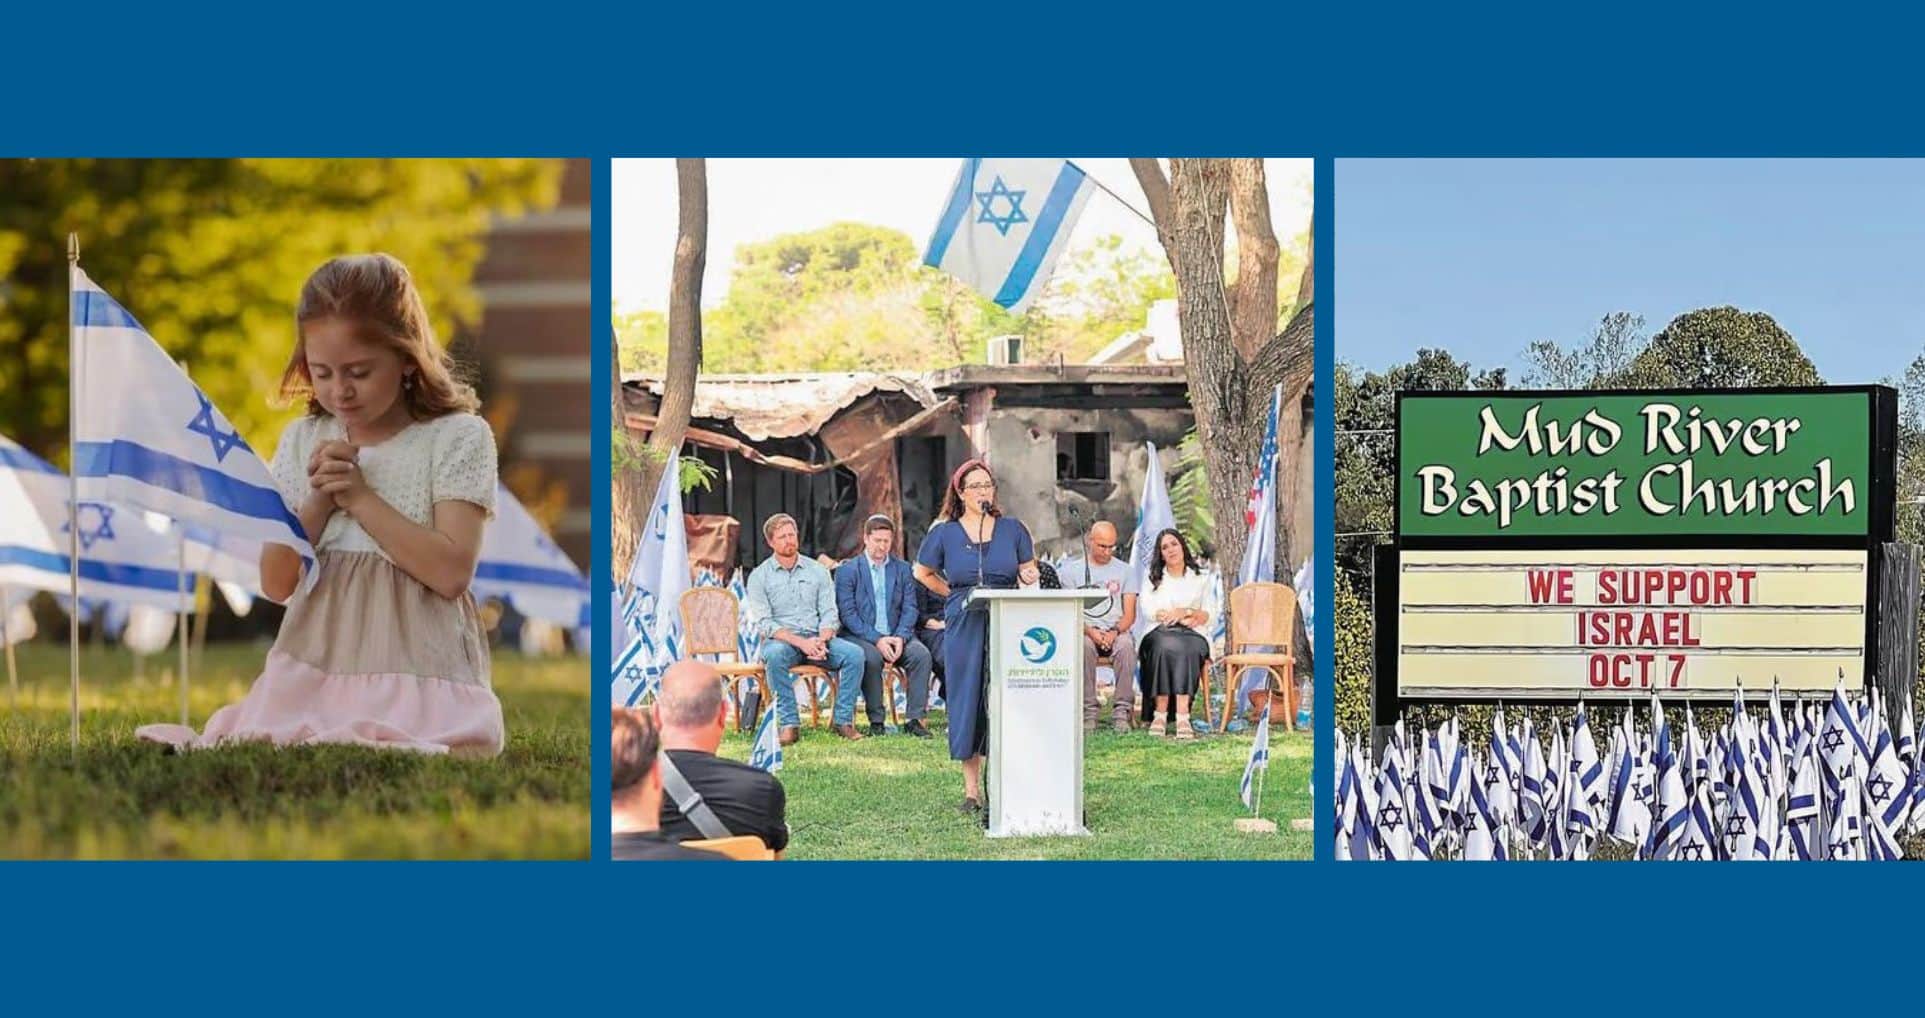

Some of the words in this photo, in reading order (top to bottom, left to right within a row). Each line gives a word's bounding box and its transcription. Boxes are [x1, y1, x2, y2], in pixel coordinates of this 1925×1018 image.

[1478, 402, 1623, 457] Mud
[1640, 403, 1803, 456] River
[1416, 465, 1624, 528] Baptist
[1639, 458, 1856, 516] Church
[1527, 570, 1574, 604] WE
[1598, 570, 1757, 605] SUPPORT
[1578, 611, 1700, 646] ISRAEL
[1589, 653, 1655, 687] OCT
[1669, 653, 1687, 687] 7
